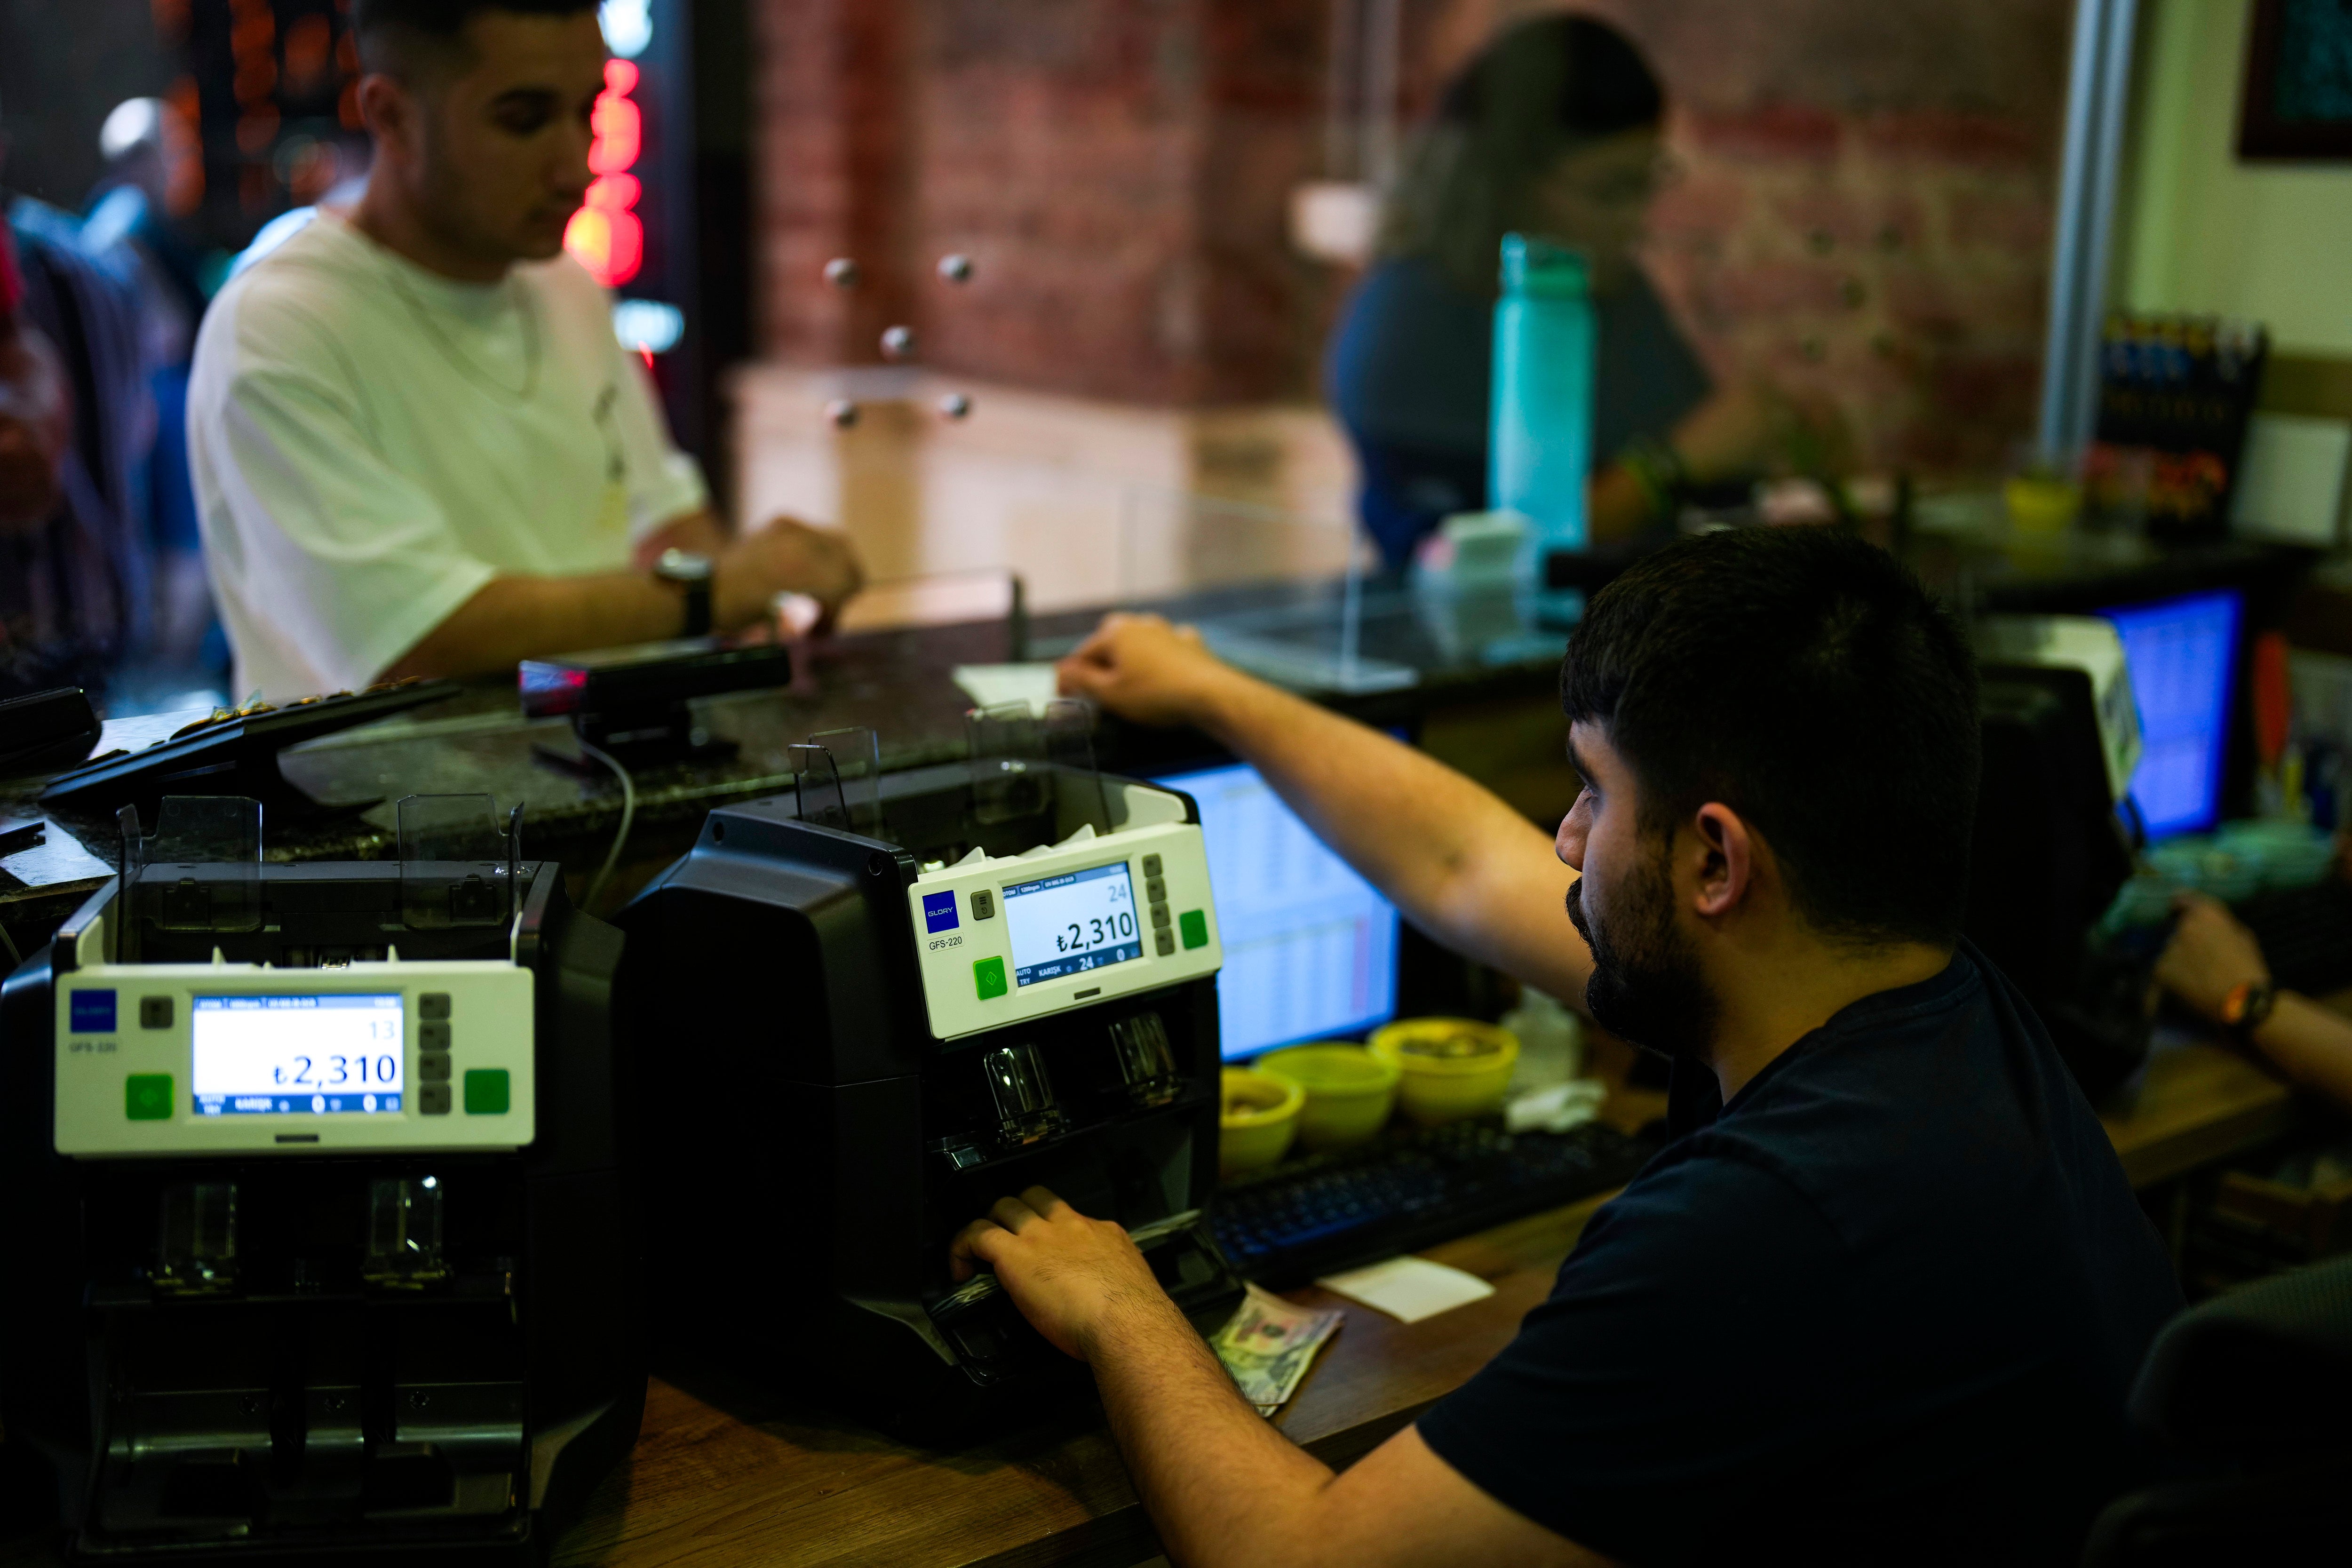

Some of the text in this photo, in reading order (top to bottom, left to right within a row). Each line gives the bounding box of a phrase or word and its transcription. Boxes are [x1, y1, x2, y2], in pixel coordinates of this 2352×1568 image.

[1108, 883, 1127, 902] 24
[928, 907, 953, 917] GLORY
[929, 936, 962, 950] GFS-220
[1116, 948, 1125, 961] 0
[1079, 955, 1094, 971] 24
[1016, 968, 1032, 977] AUTO
[1019, 978, 1030, 986] TRY
[368, 1020, 395, 1040] 13
[312, 1094, 326, 1114] 0
[363, 1093, 377, 1114] 0
